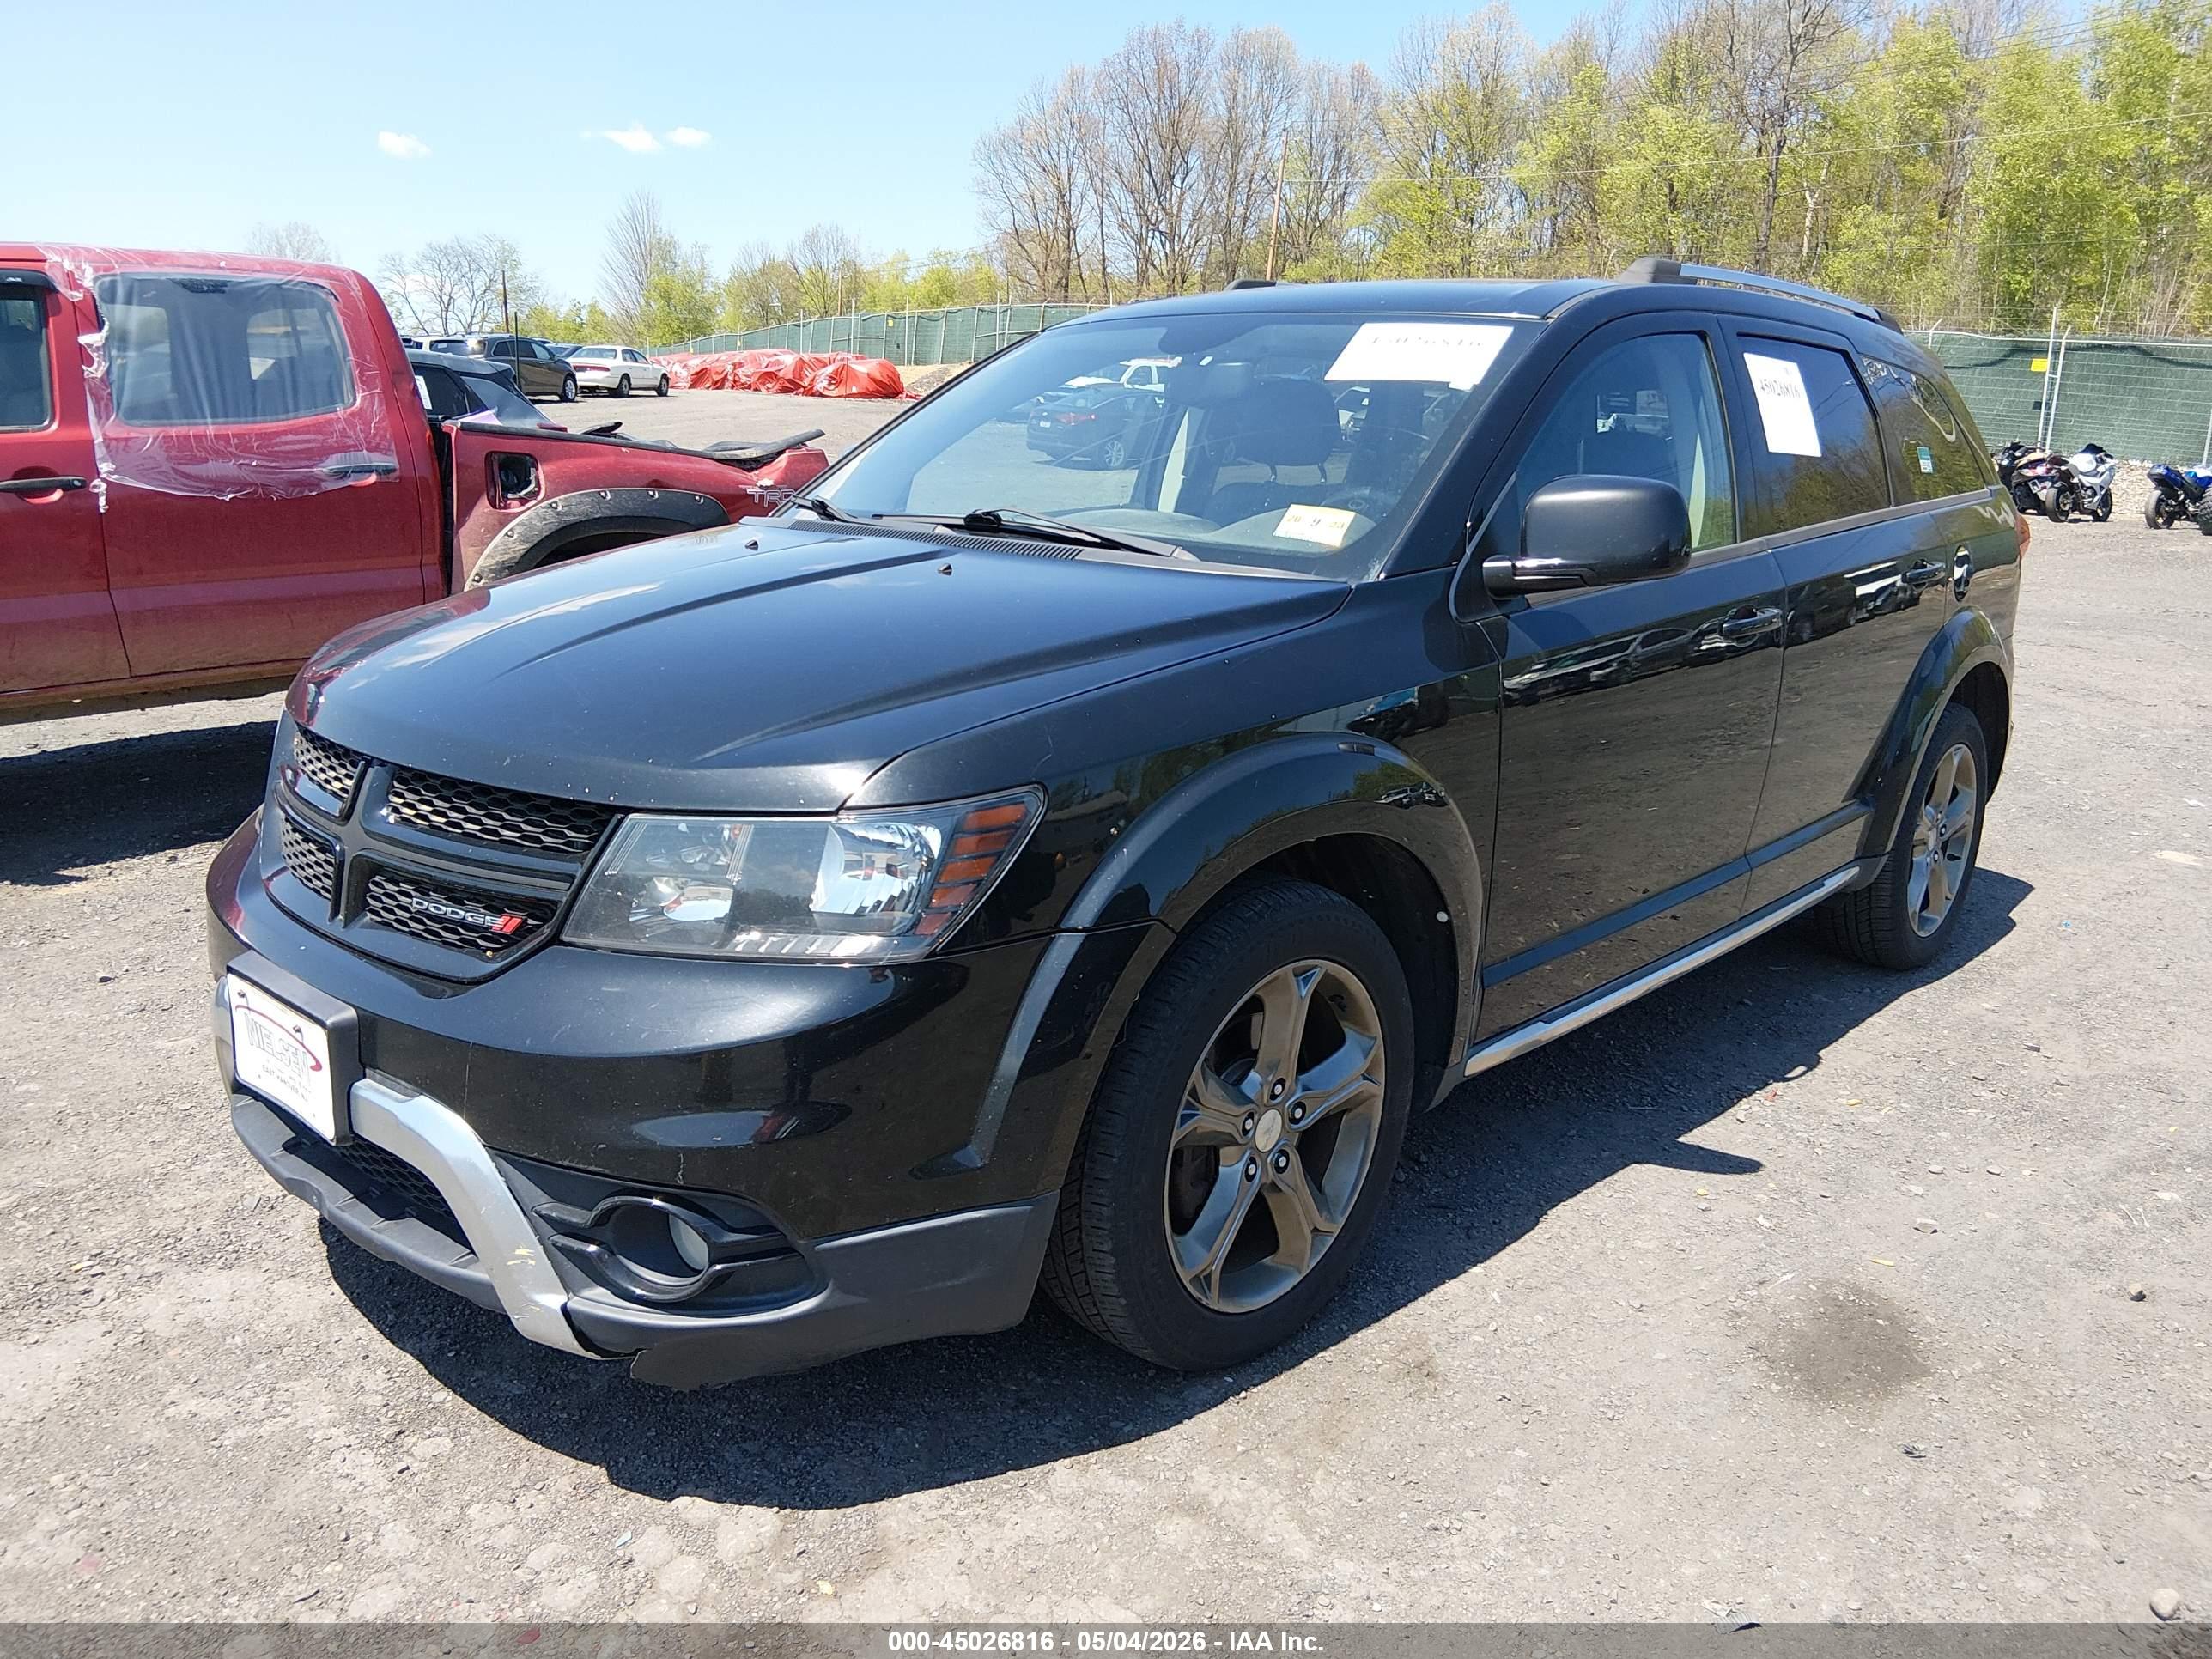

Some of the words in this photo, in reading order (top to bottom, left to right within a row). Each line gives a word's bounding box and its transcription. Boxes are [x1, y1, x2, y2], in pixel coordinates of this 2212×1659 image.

[746, 489, 797, 508] TRD
[412, 897, 505, 928] DODGE
[244, 1012, 311, 1087] NIELSEN
